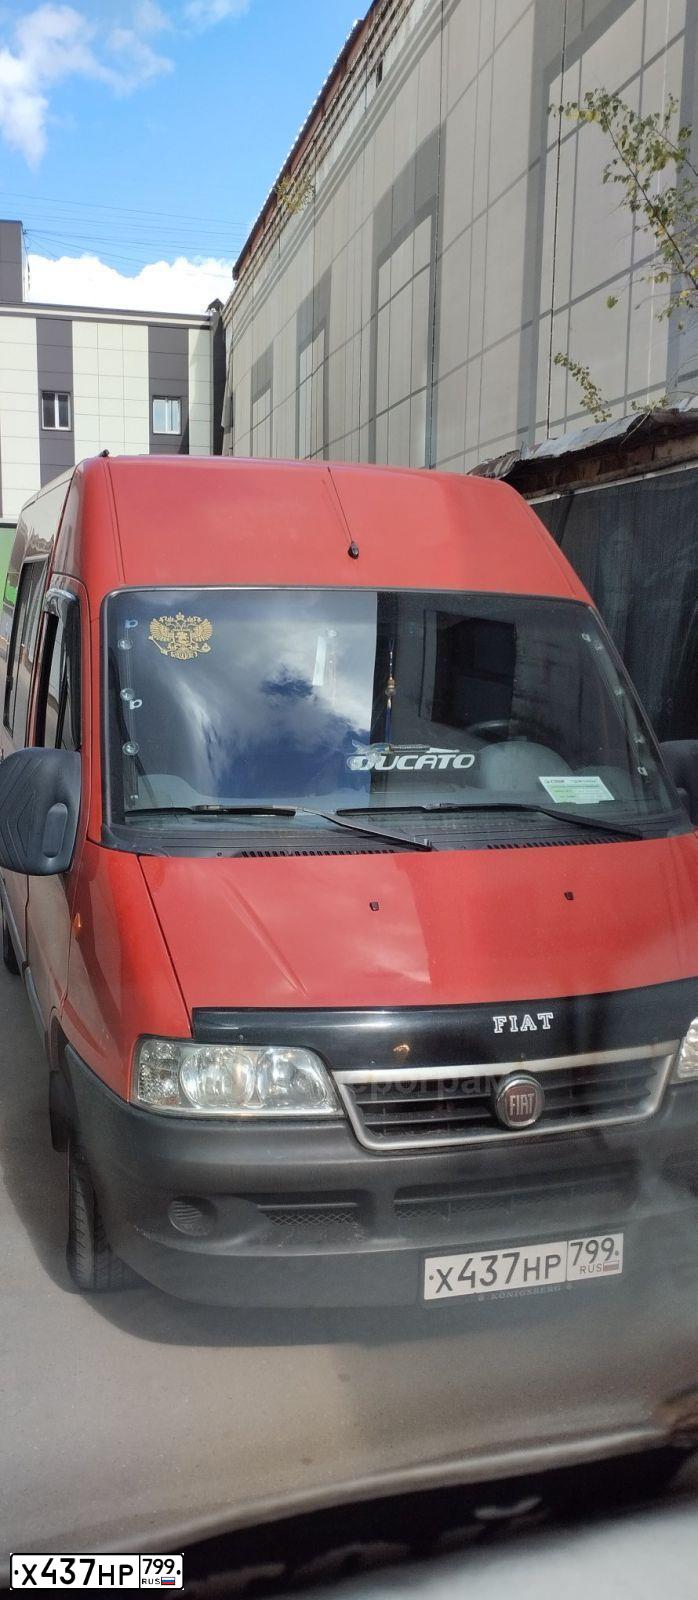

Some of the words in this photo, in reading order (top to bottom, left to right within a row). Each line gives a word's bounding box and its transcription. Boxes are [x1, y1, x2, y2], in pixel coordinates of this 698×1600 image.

[347, 753, 476, 771] DUCATO
[493, 1012, 554, 1034] FIAT
[508, 1092, 536, 1117] FIAT
[570, 1237, 616, 1266] 799
[579, 1262, 604, 1275] RUS
